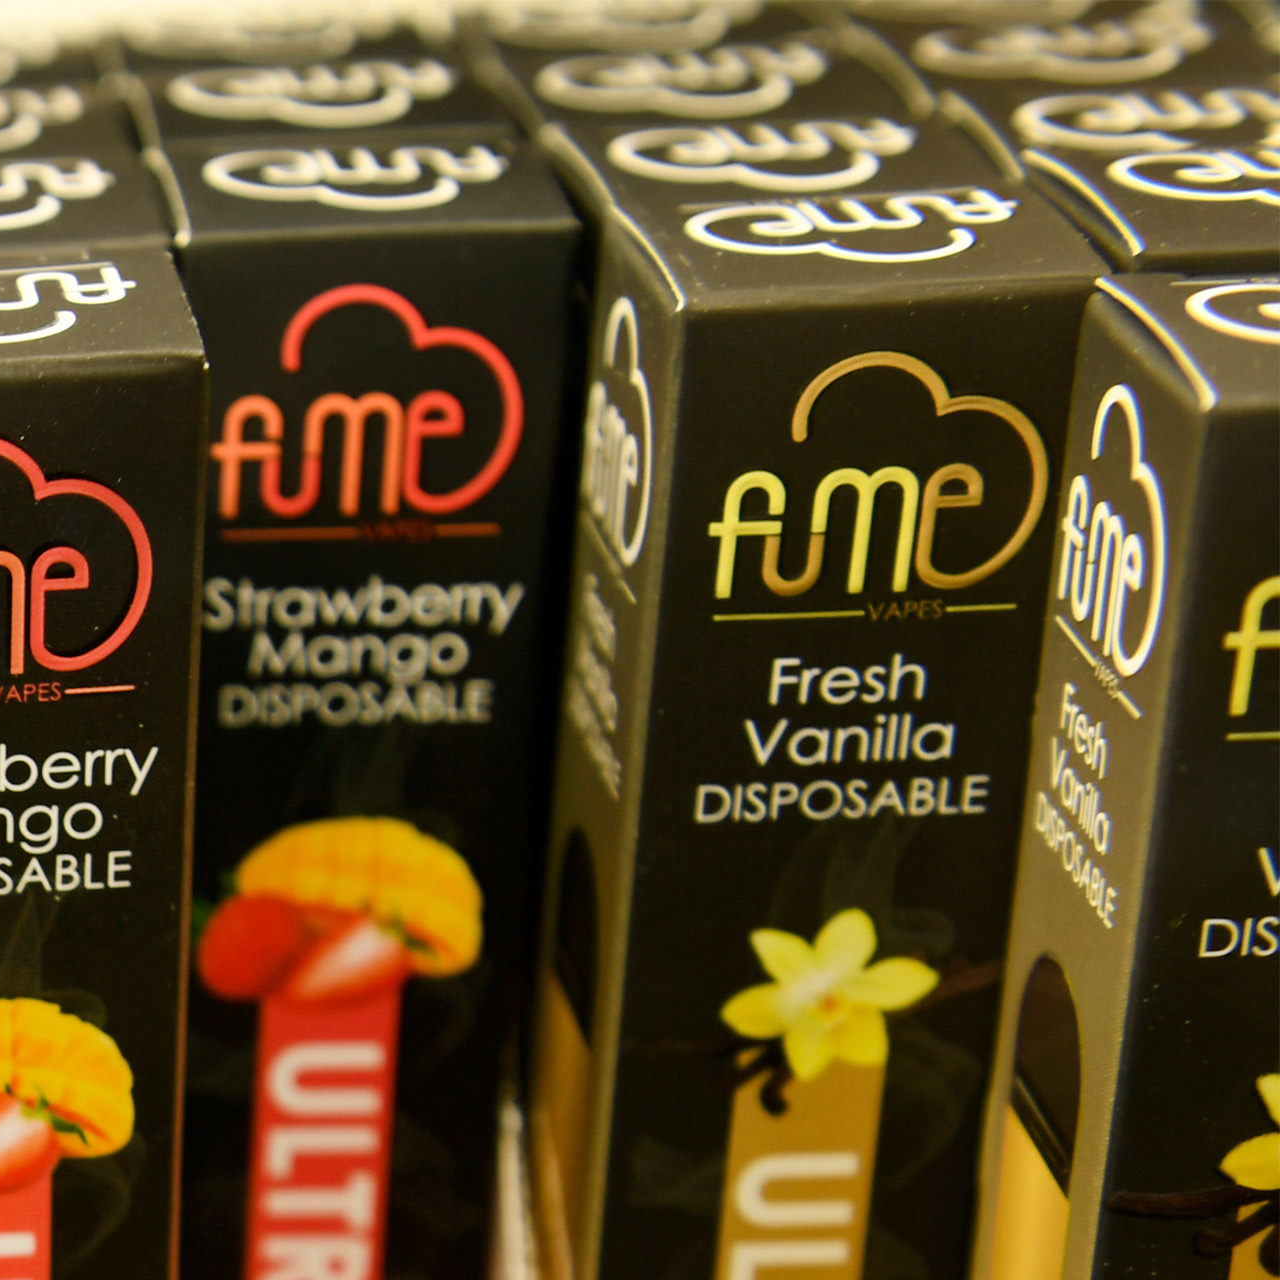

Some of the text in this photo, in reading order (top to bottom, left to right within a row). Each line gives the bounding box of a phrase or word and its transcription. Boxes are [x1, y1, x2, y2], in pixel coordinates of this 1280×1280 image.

[203, 577, 524, 633] Strawberry
[867, 600, 944, 620] VAPES
[248, 629, 469, 684] Mango
[768, 653, 926, 706] Fresh
[218, 678, 494, 727] DISPOSABLE
[745, 713, 957, 766] Vanilla
[1060, 682, 1107, 779] Fresh
[693, 775, 991, 824] DISPOSABLE
[1050, 736, 1111, 854] Vanilla
